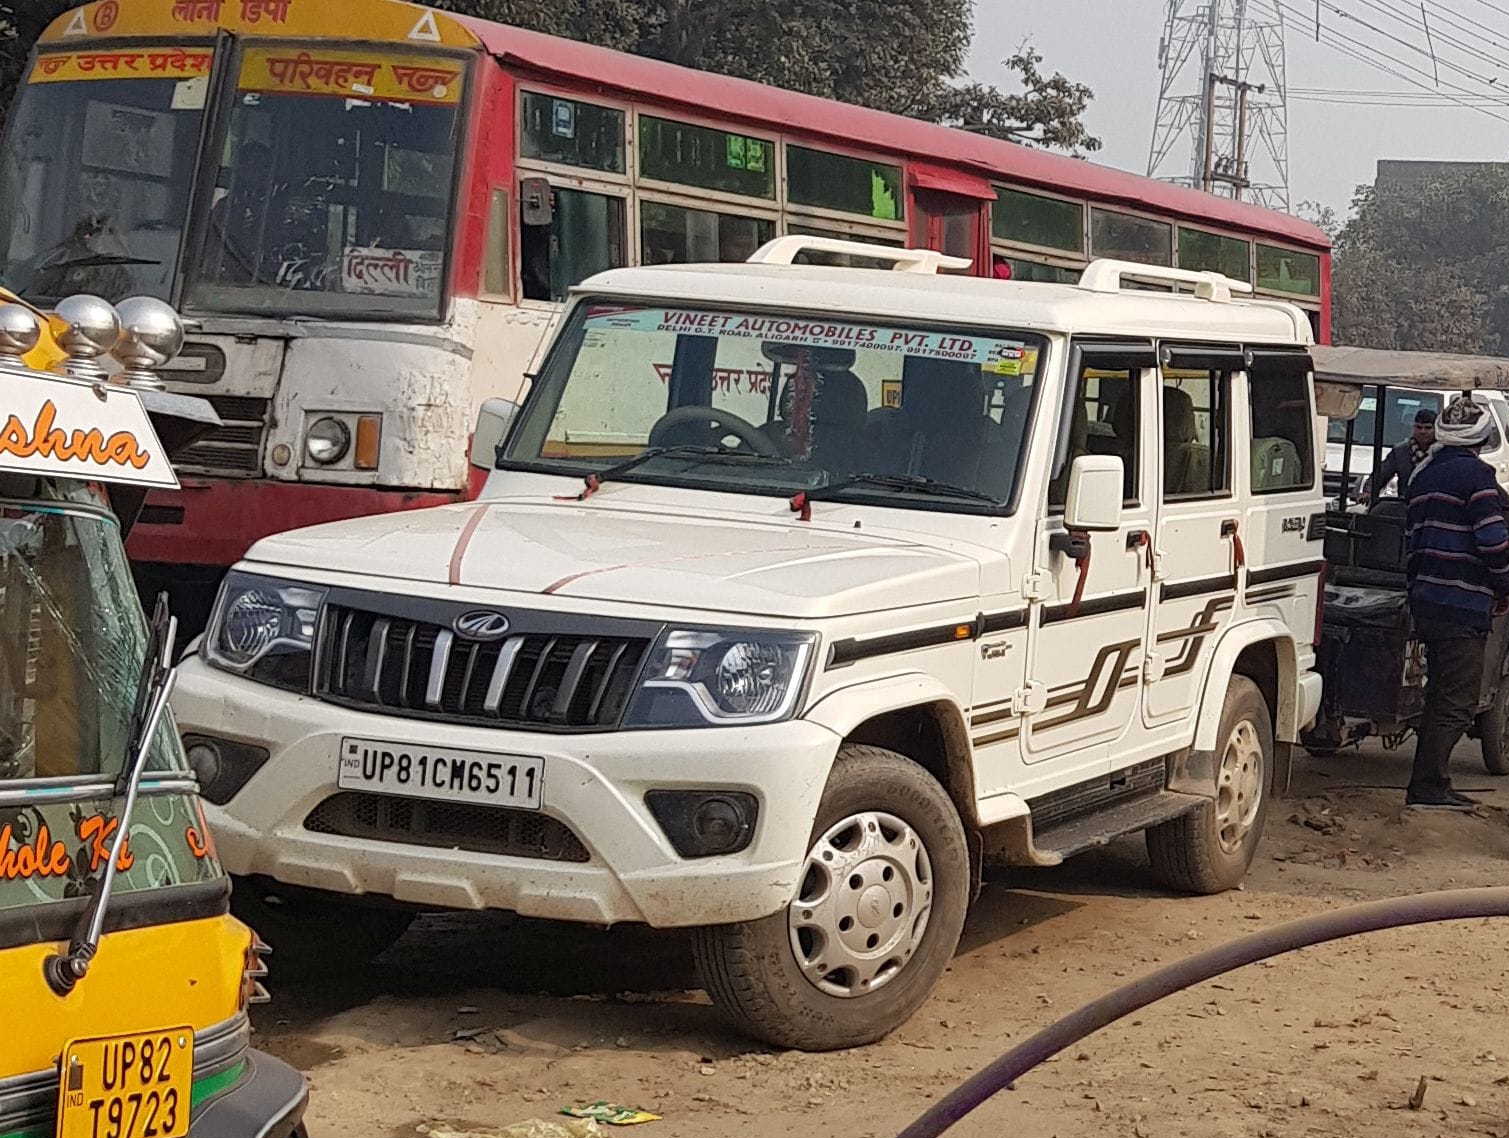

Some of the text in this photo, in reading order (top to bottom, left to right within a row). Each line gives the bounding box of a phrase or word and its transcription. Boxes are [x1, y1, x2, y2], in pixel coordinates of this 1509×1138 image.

[76, 53, 144, 72] उत्तर
[266, 53, 380, 89] परिवहन
[347, 250, 413, 285] दिल्ली
[657, 324, 690, 333] DELHI
[694, 327, 717, 335] G.T.
[755, 333, 808, 343] ALIGARH
[664, 311, 978, 353] VINEET AUTOMOBILES PVT. LTD.
[362, 749, 535, 798] UP81CM6511
[102, 1037, 172, 1092] UP82
[66, 1092, 84, 1108] IND
